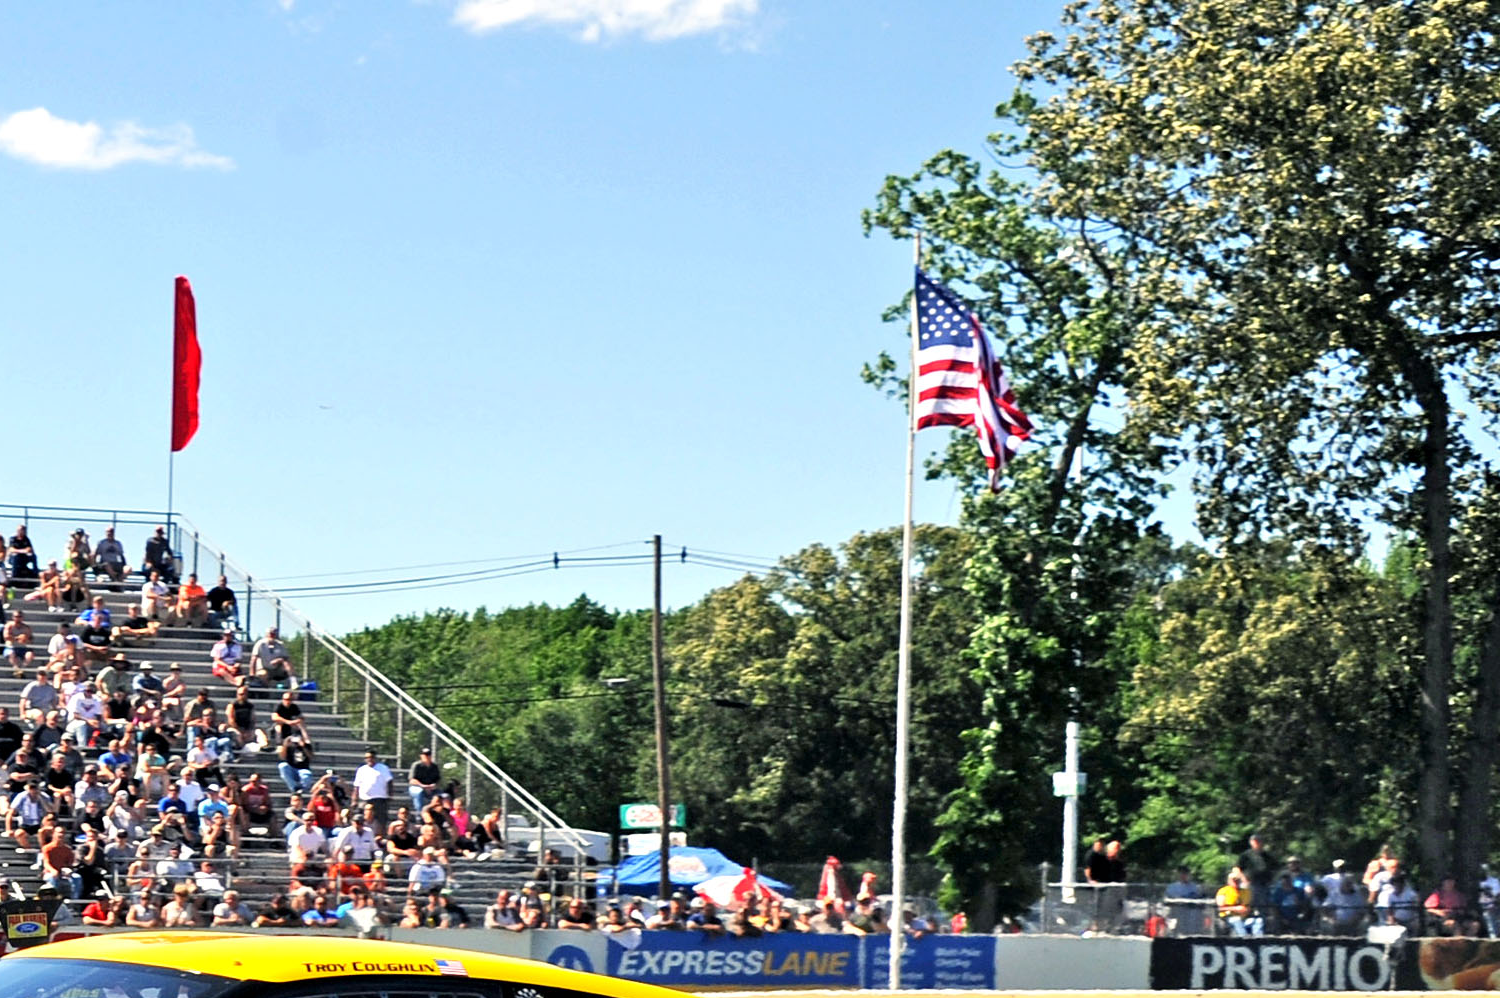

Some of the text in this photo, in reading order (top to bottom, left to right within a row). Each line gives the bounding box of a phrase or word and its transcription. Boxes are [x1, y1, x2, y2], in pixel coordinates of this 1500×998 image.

[303, 961, 436, 973] TROY COUGHLIN
[617, 950, 848, 976] EXPRESSLANE
[1190, 944, 1390, 991] PREMIO
